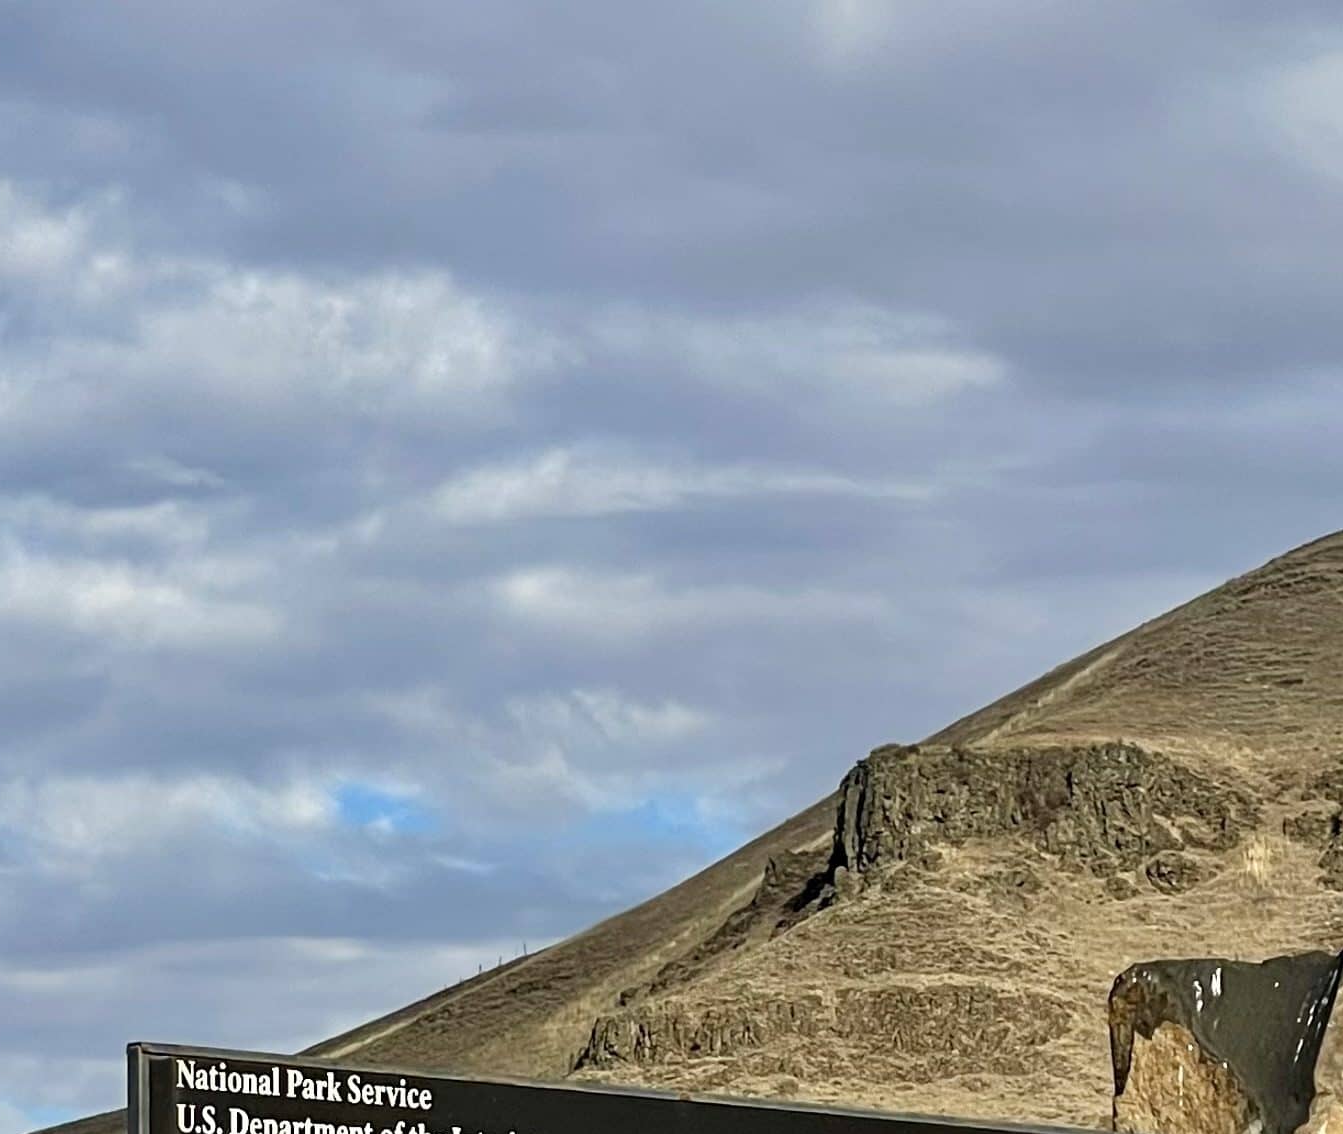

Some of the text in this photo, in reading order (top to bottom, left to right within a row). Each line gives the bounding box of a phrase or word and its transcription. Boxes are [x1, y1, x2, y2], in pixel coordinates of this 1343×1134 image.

[175, 1059, 433, 1110] National Park Service
